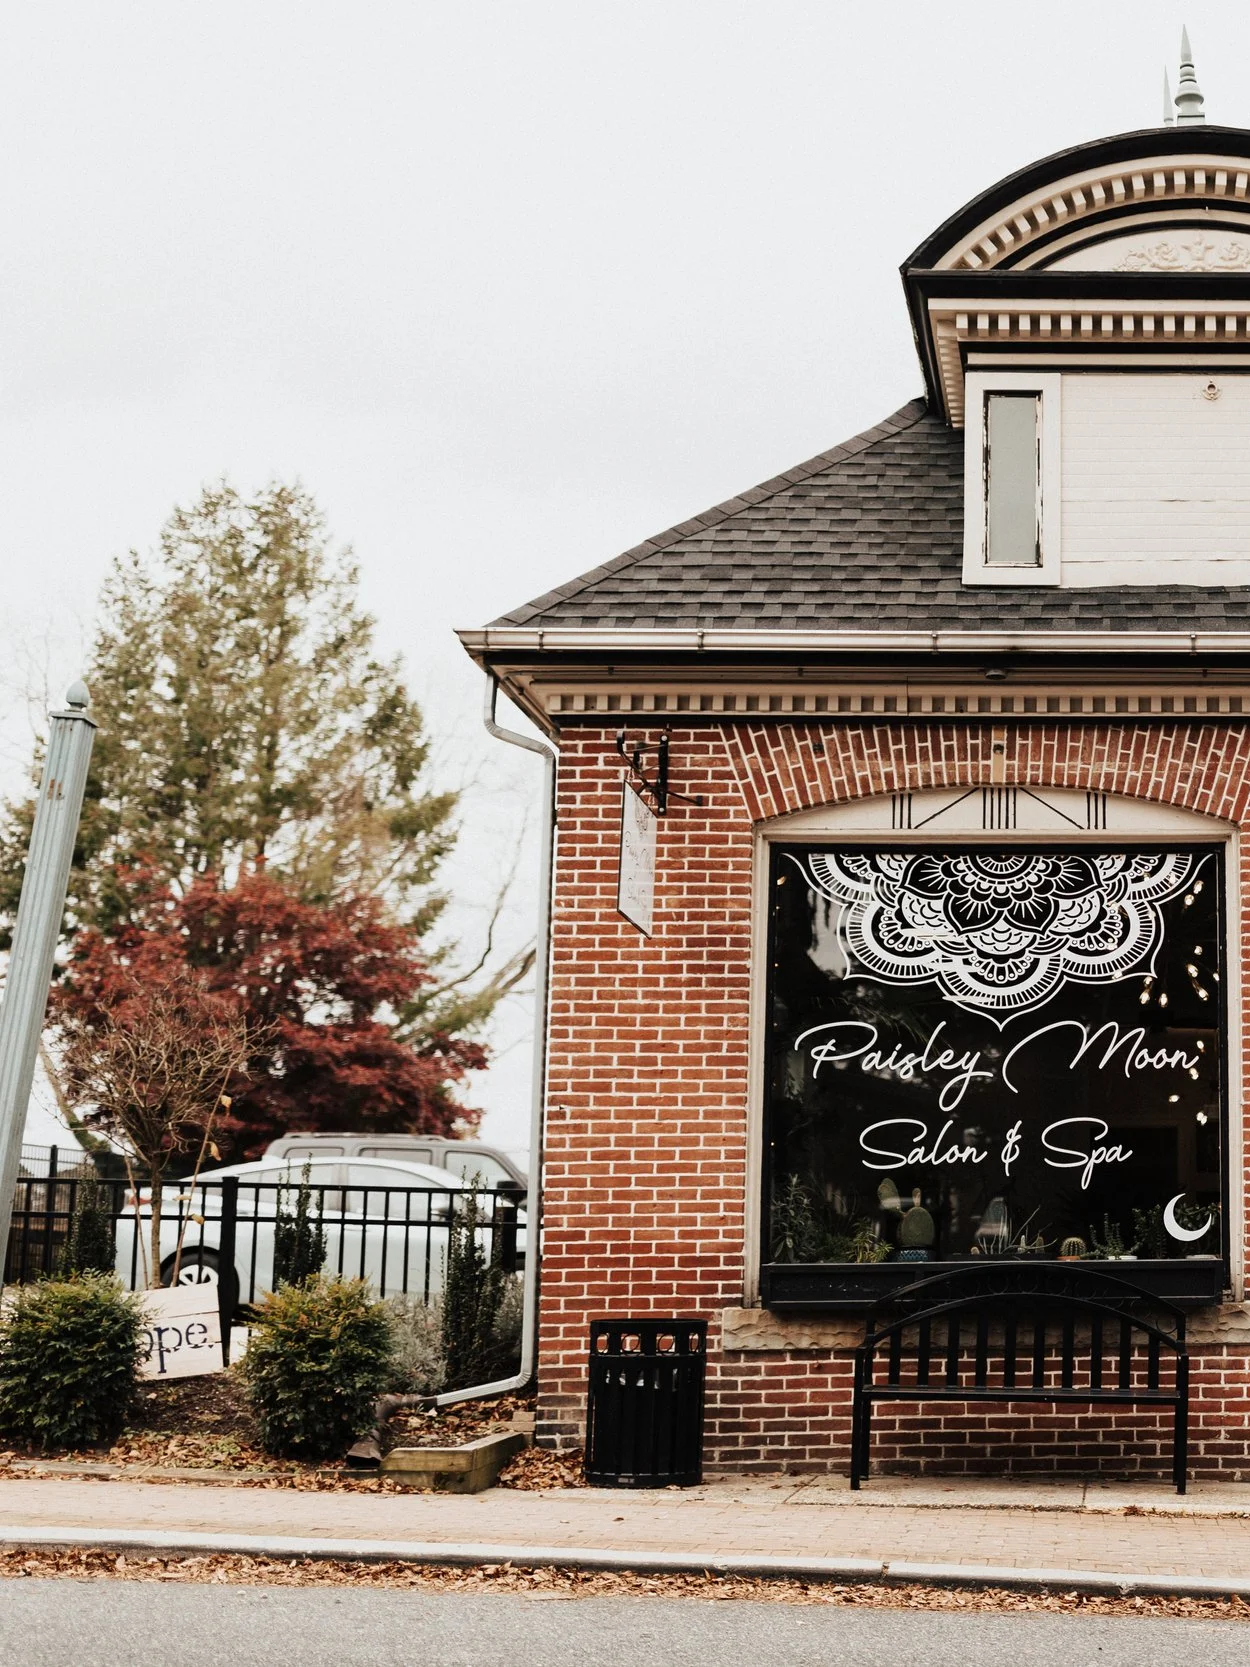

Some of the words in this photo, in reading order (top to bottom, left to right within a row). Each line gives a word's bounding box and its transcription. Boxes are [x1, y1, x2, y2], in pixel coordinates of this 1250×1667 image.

[794, 1020, 993, 1112] Paisley
[1002, 1020, 1199, 1093] Moon
[859, 1118, 988, 1170] Salon
[1000, 1120, 1022, 1177] &
[1041, 1117, 1133, 1190] Spa
